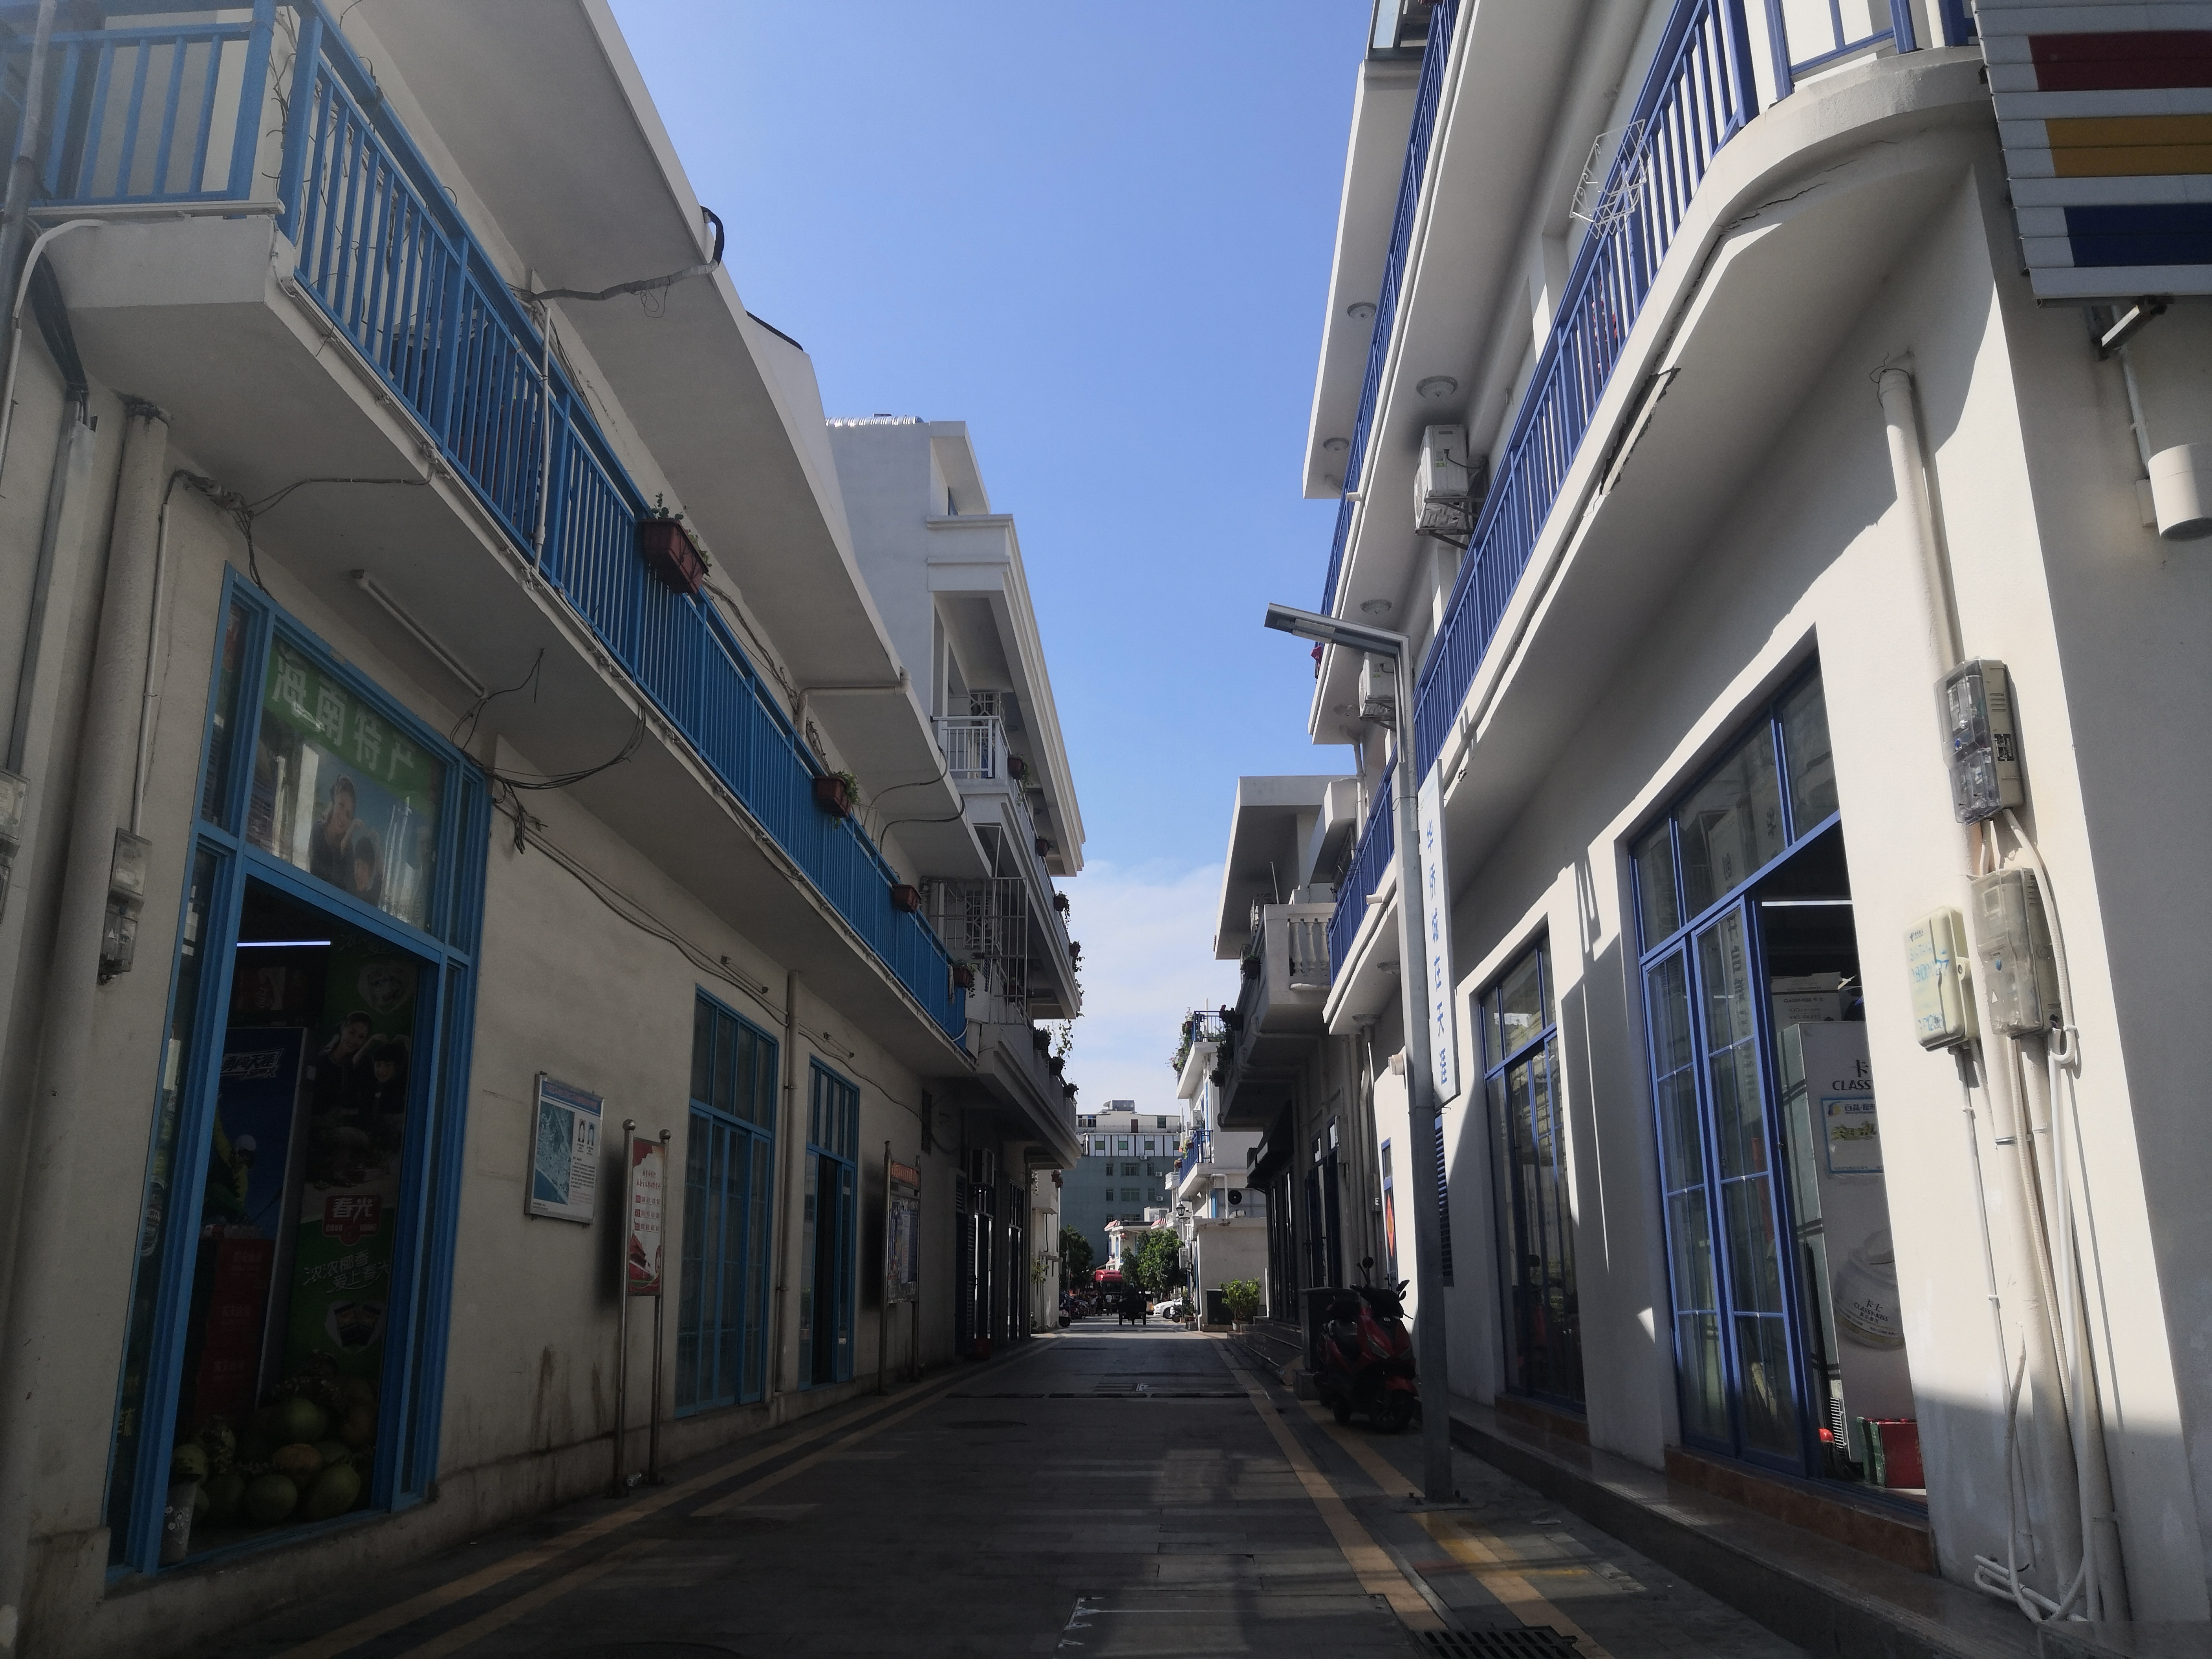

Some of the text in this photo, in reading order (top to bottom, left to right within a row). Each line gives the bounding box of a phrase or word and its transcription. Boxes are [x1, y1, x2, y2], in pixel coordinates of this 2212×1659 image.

[272, 655, 416, 782] 海南特产
[223, 1052, 276, 1071] 勇闯天涯
[1833, 1080, 1873, 1091] CLASS
[332, 1197, 374, 1223] 春光
[302, 1249, 370, 1286] 浓浓椰香
